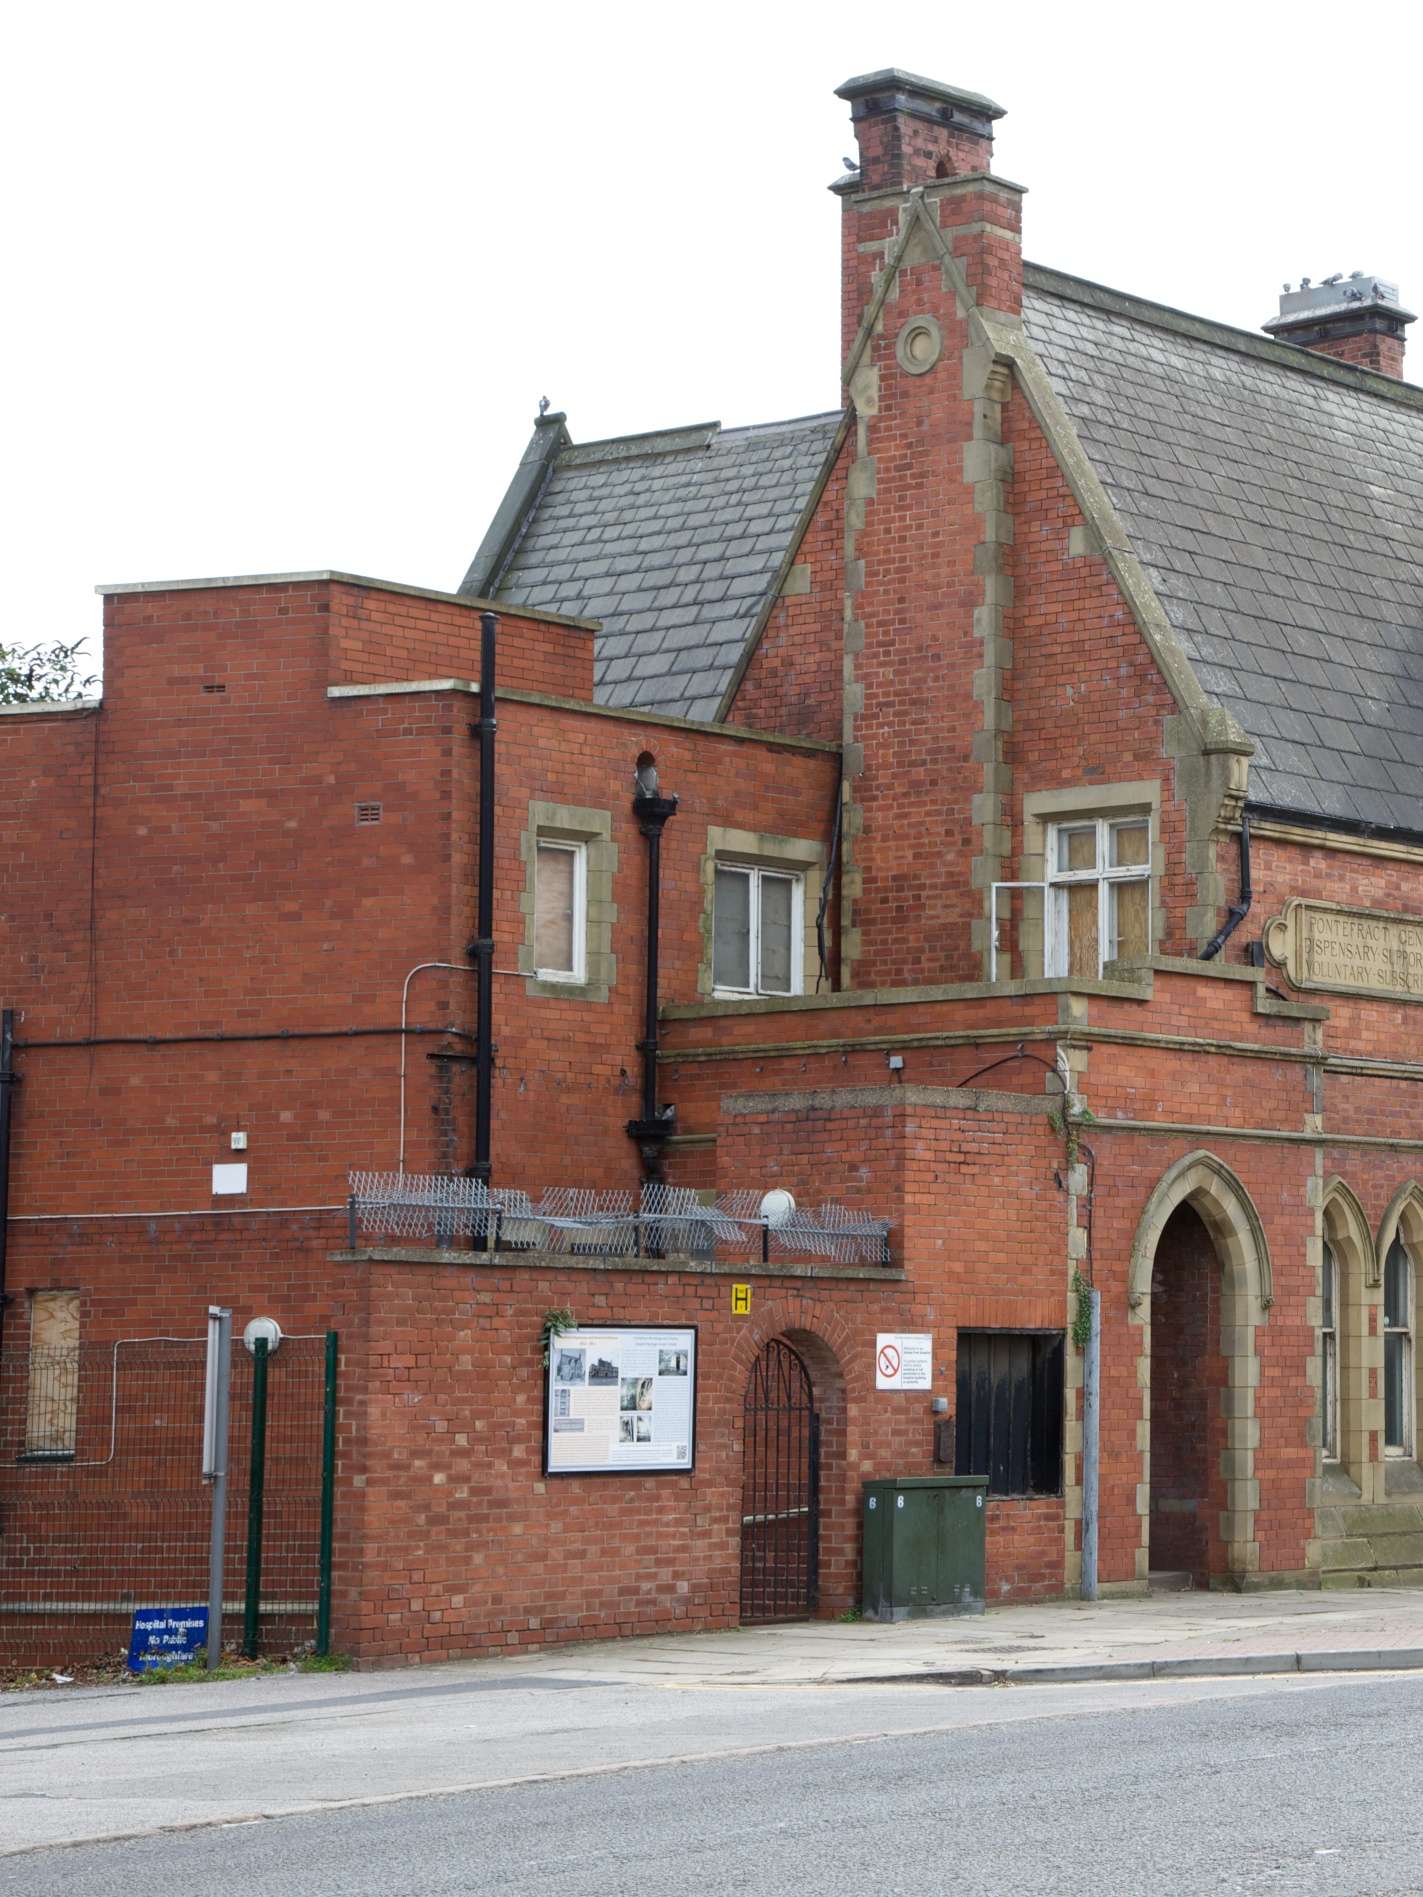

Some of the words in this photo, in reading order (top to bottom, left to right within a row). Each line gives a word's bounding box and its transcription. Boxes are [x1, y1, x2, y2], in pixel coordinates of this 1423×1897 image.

[1309, 916, 1389, 943] PONTEFRACT
[1304, 937, 1378, 962] DISPENSARY
[1305, 959, 1372, 983] VOLUNTARY
[735, 1287, 748, 1311] H
[897, 1495, 904, 1508] 6
[135, 1619, 167, 1631] Hospital
[167, 1618, 204, 1629] Premises
[148, 1635, 160, 1645] No
[162, 1635, 187, 1645] Public
